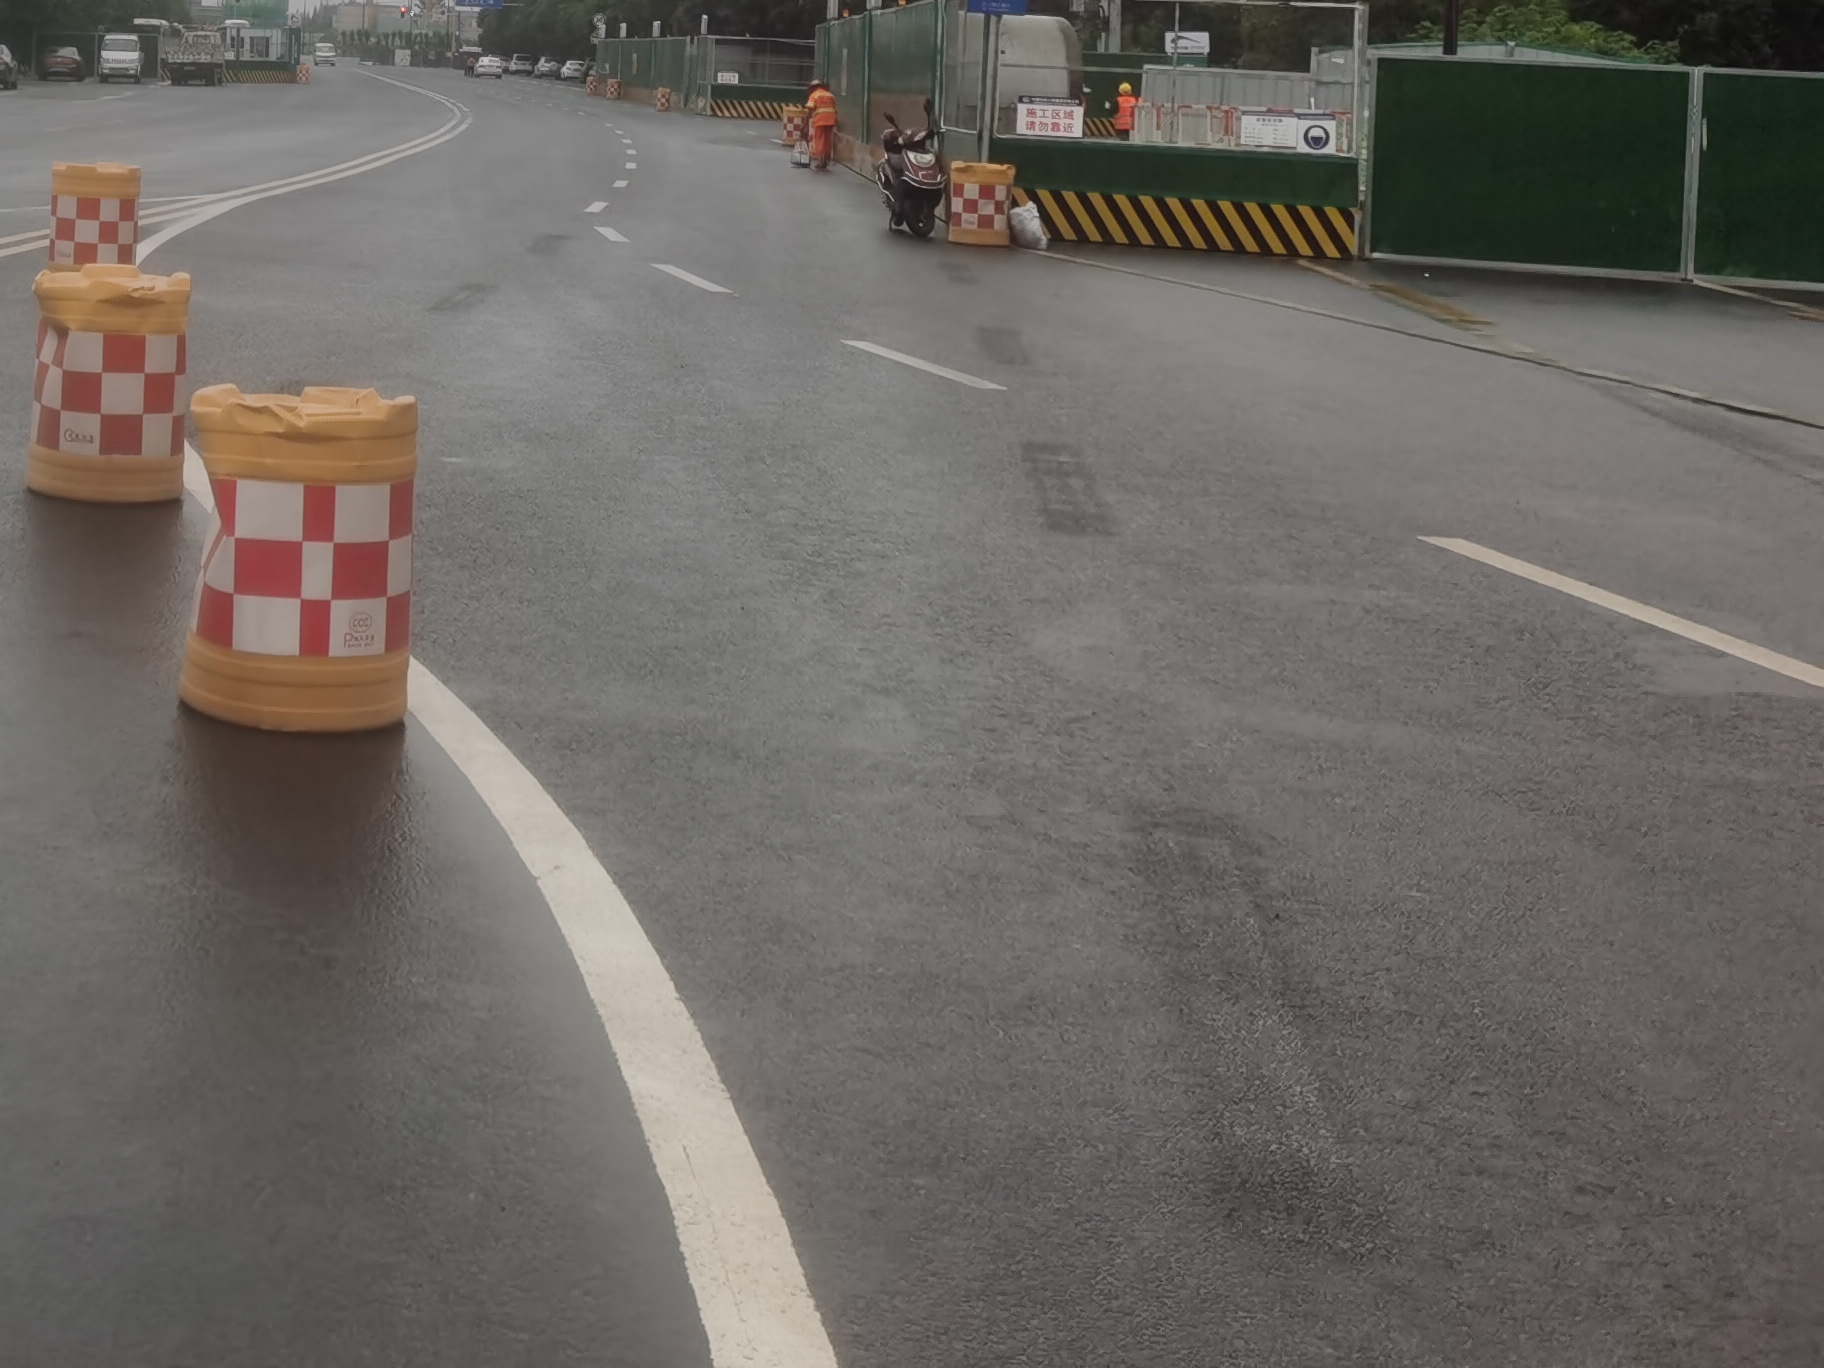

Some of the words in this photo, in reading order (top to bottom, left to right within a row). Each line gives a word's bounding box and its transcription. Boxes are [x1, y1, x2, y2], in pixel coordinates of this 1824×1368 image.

[1025, 108, 1075, 120] 施工区域
[1025, 120, 1075, 134] 请勿靠近
